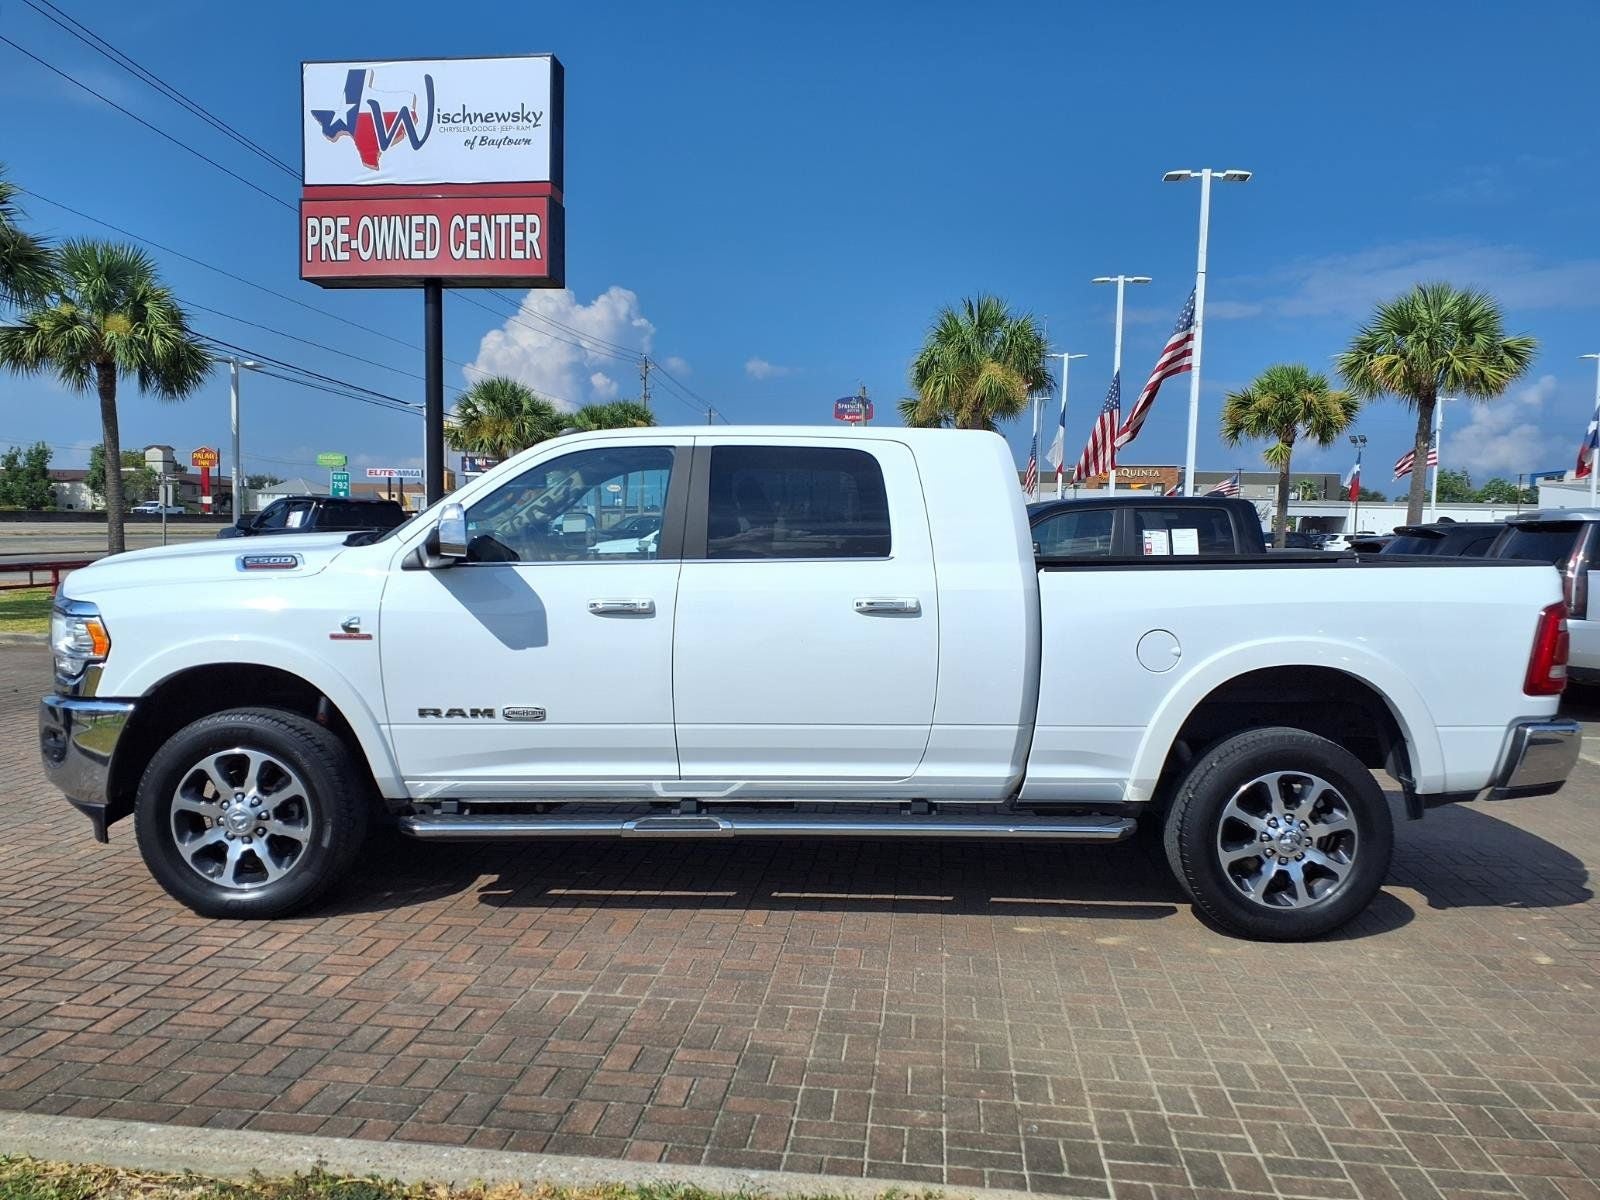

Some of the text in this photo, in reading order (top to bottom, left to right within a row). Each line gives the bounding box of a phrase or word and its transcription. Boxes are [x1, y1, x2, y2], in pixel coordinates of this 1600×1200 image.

[464, 135, 532, 150] of Baytown
[306, 214, 542, 262] PRE-OWNED CENTER
[368, 469, 394, 477] ELITE
[1121, 468, 1160, 478] QUINTA
[333, 481, 349, 490] 792
[418, 708, 495, 718] RAM
